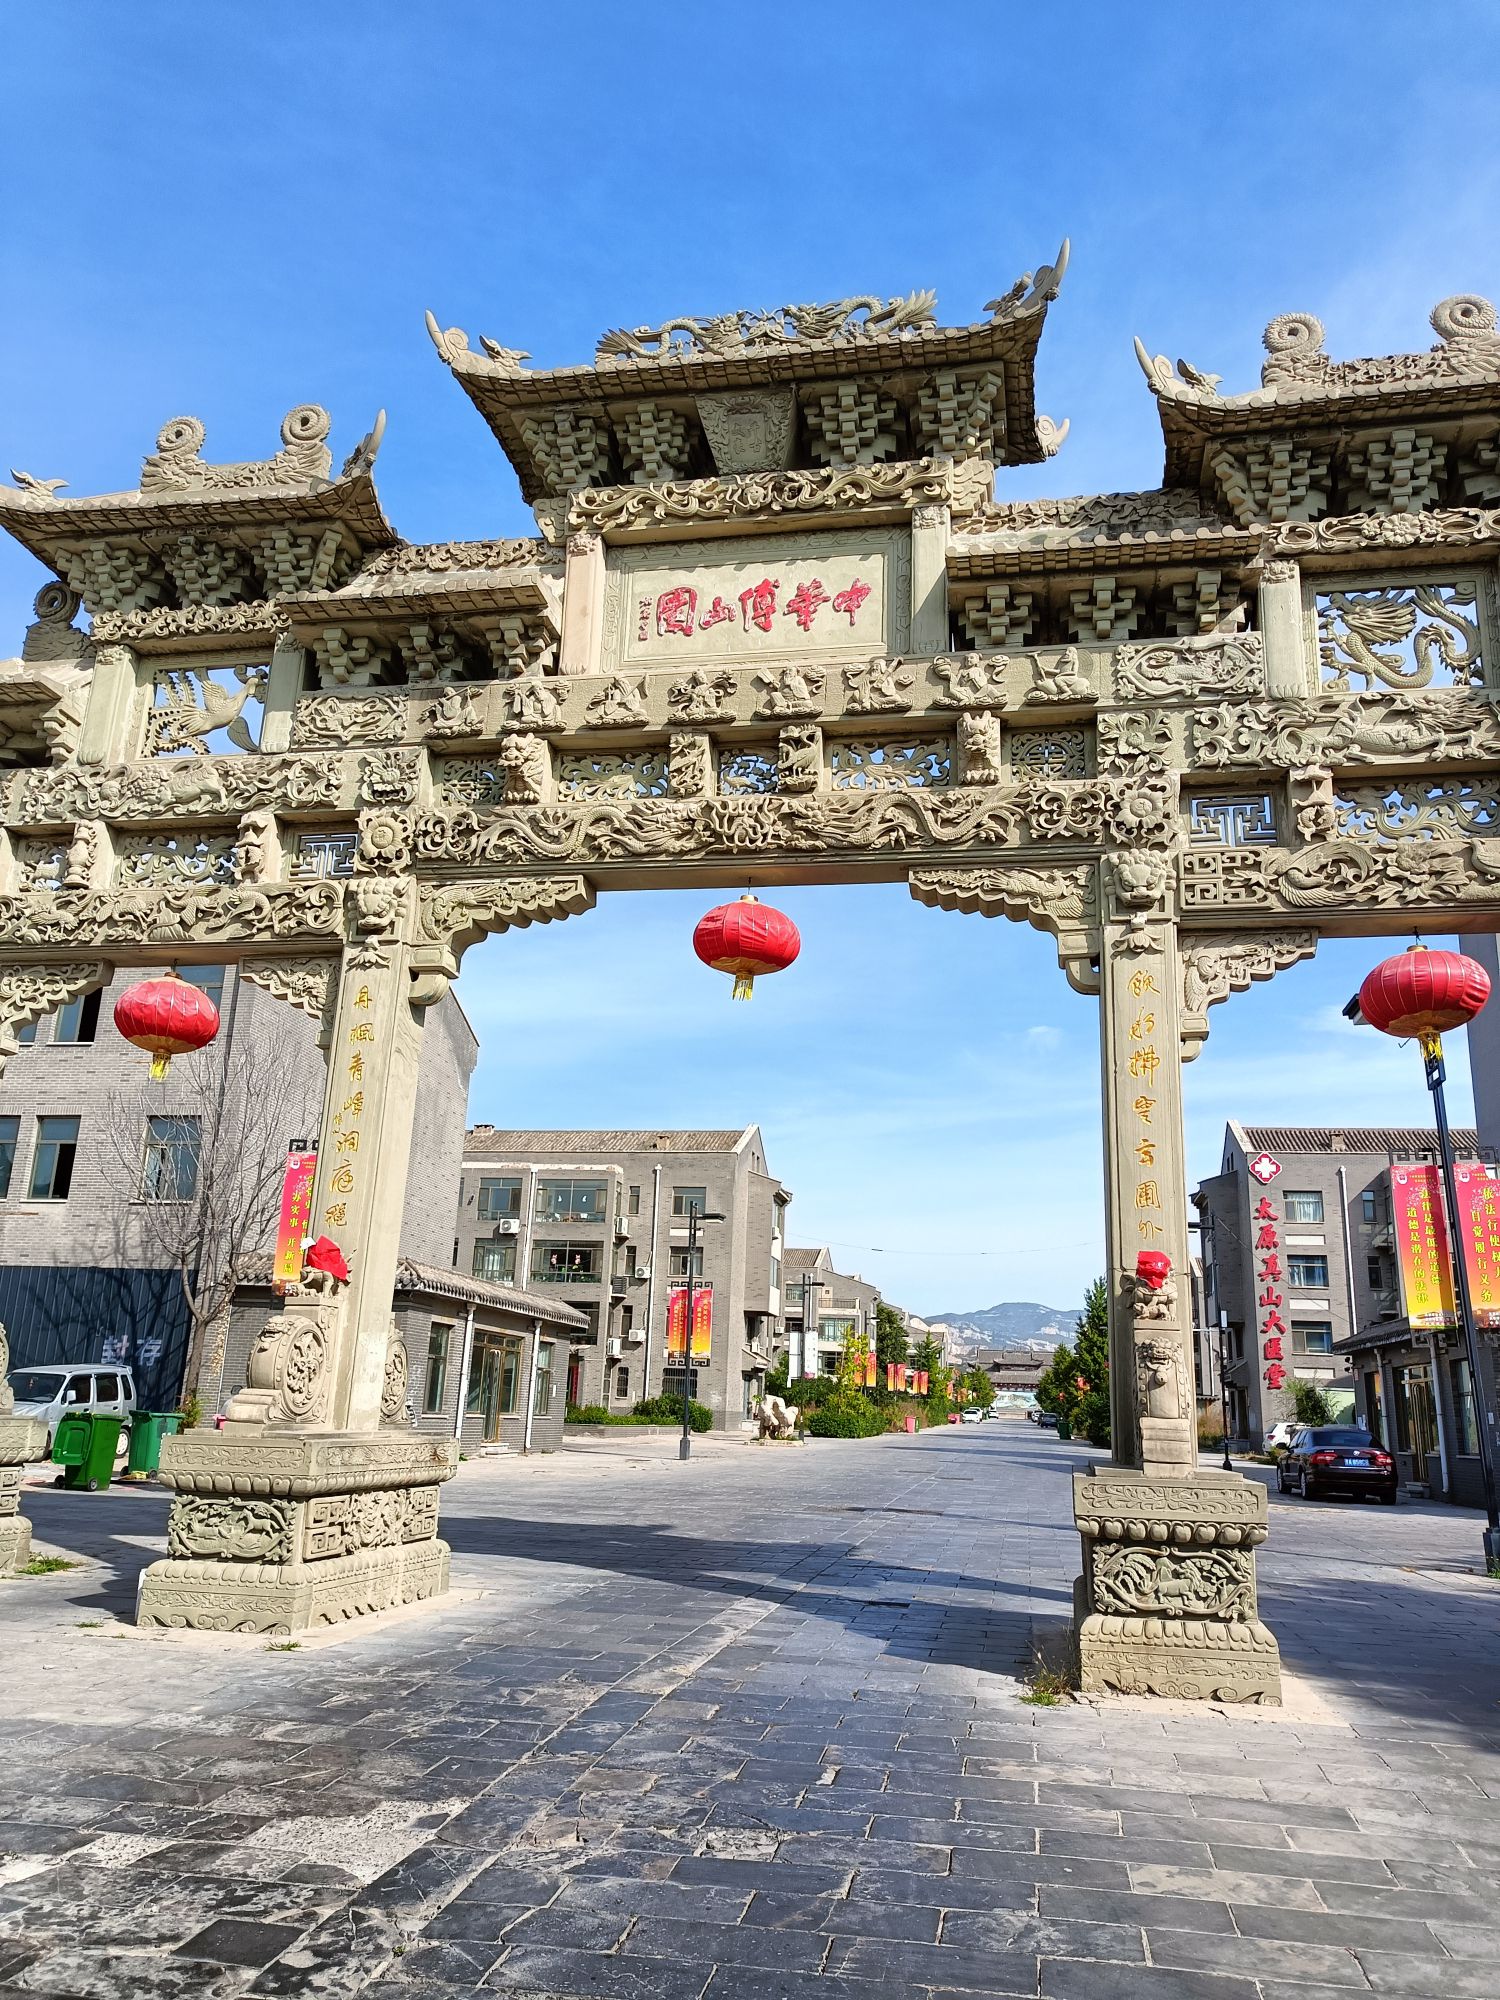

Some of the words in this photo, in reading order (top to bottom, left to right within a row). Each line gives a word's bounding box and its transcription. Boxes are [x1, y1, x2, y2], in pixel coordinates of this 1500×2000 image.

[289, 1190, 302, 1228] 办实事
[1406, 1206, 1429, 1304] 道德是潜在的法律
[1419, 1187, 1441, 1286] 法律是最低的道德
[1471, 1210, 1492, 1303] 自觉履行义务
[101, 1334, 162, 1367] 封存
